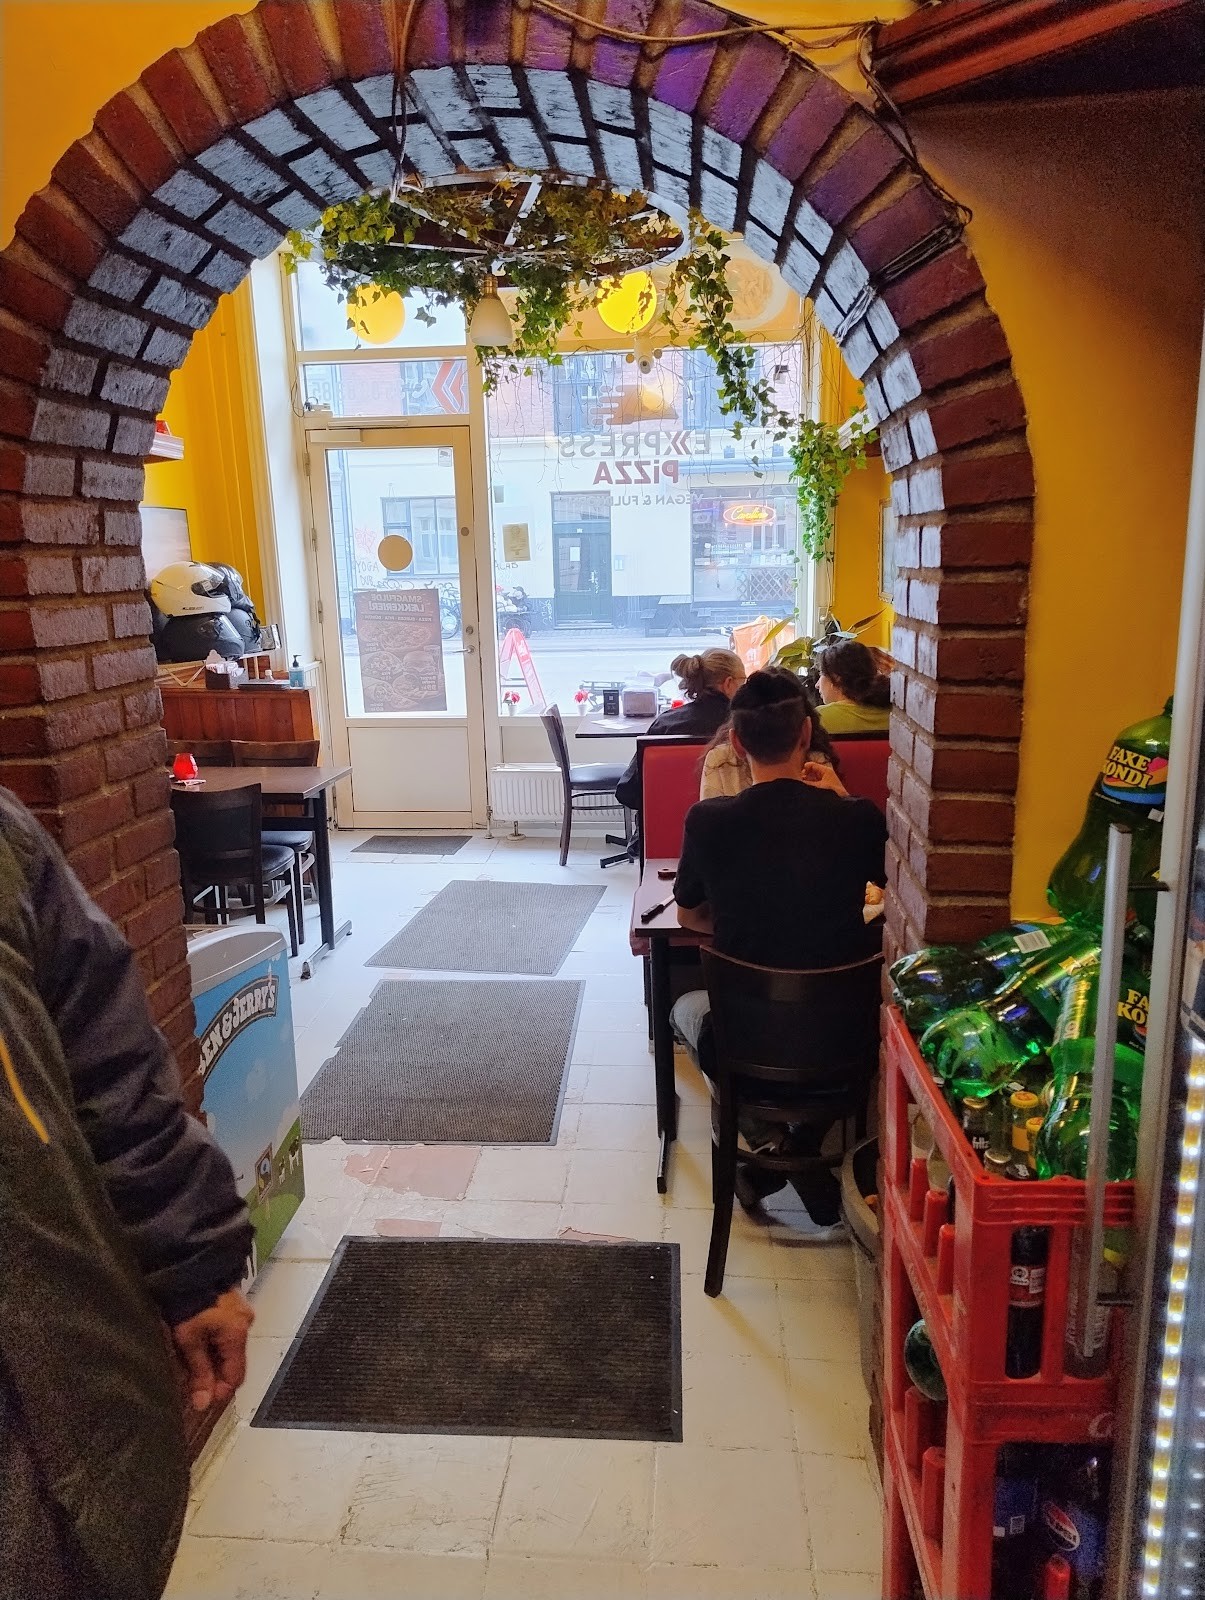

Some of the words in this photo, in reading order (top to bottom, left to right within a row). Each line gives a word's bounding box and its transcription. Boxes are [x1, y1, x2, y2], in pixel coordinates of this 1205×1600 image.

[1109, 746, 1151, 771] FAXE
[1103, 761, 1153, 789] ONDI
[1117, 998, 1149, 1025] KO
[222, 1012, 232, 1039] &
